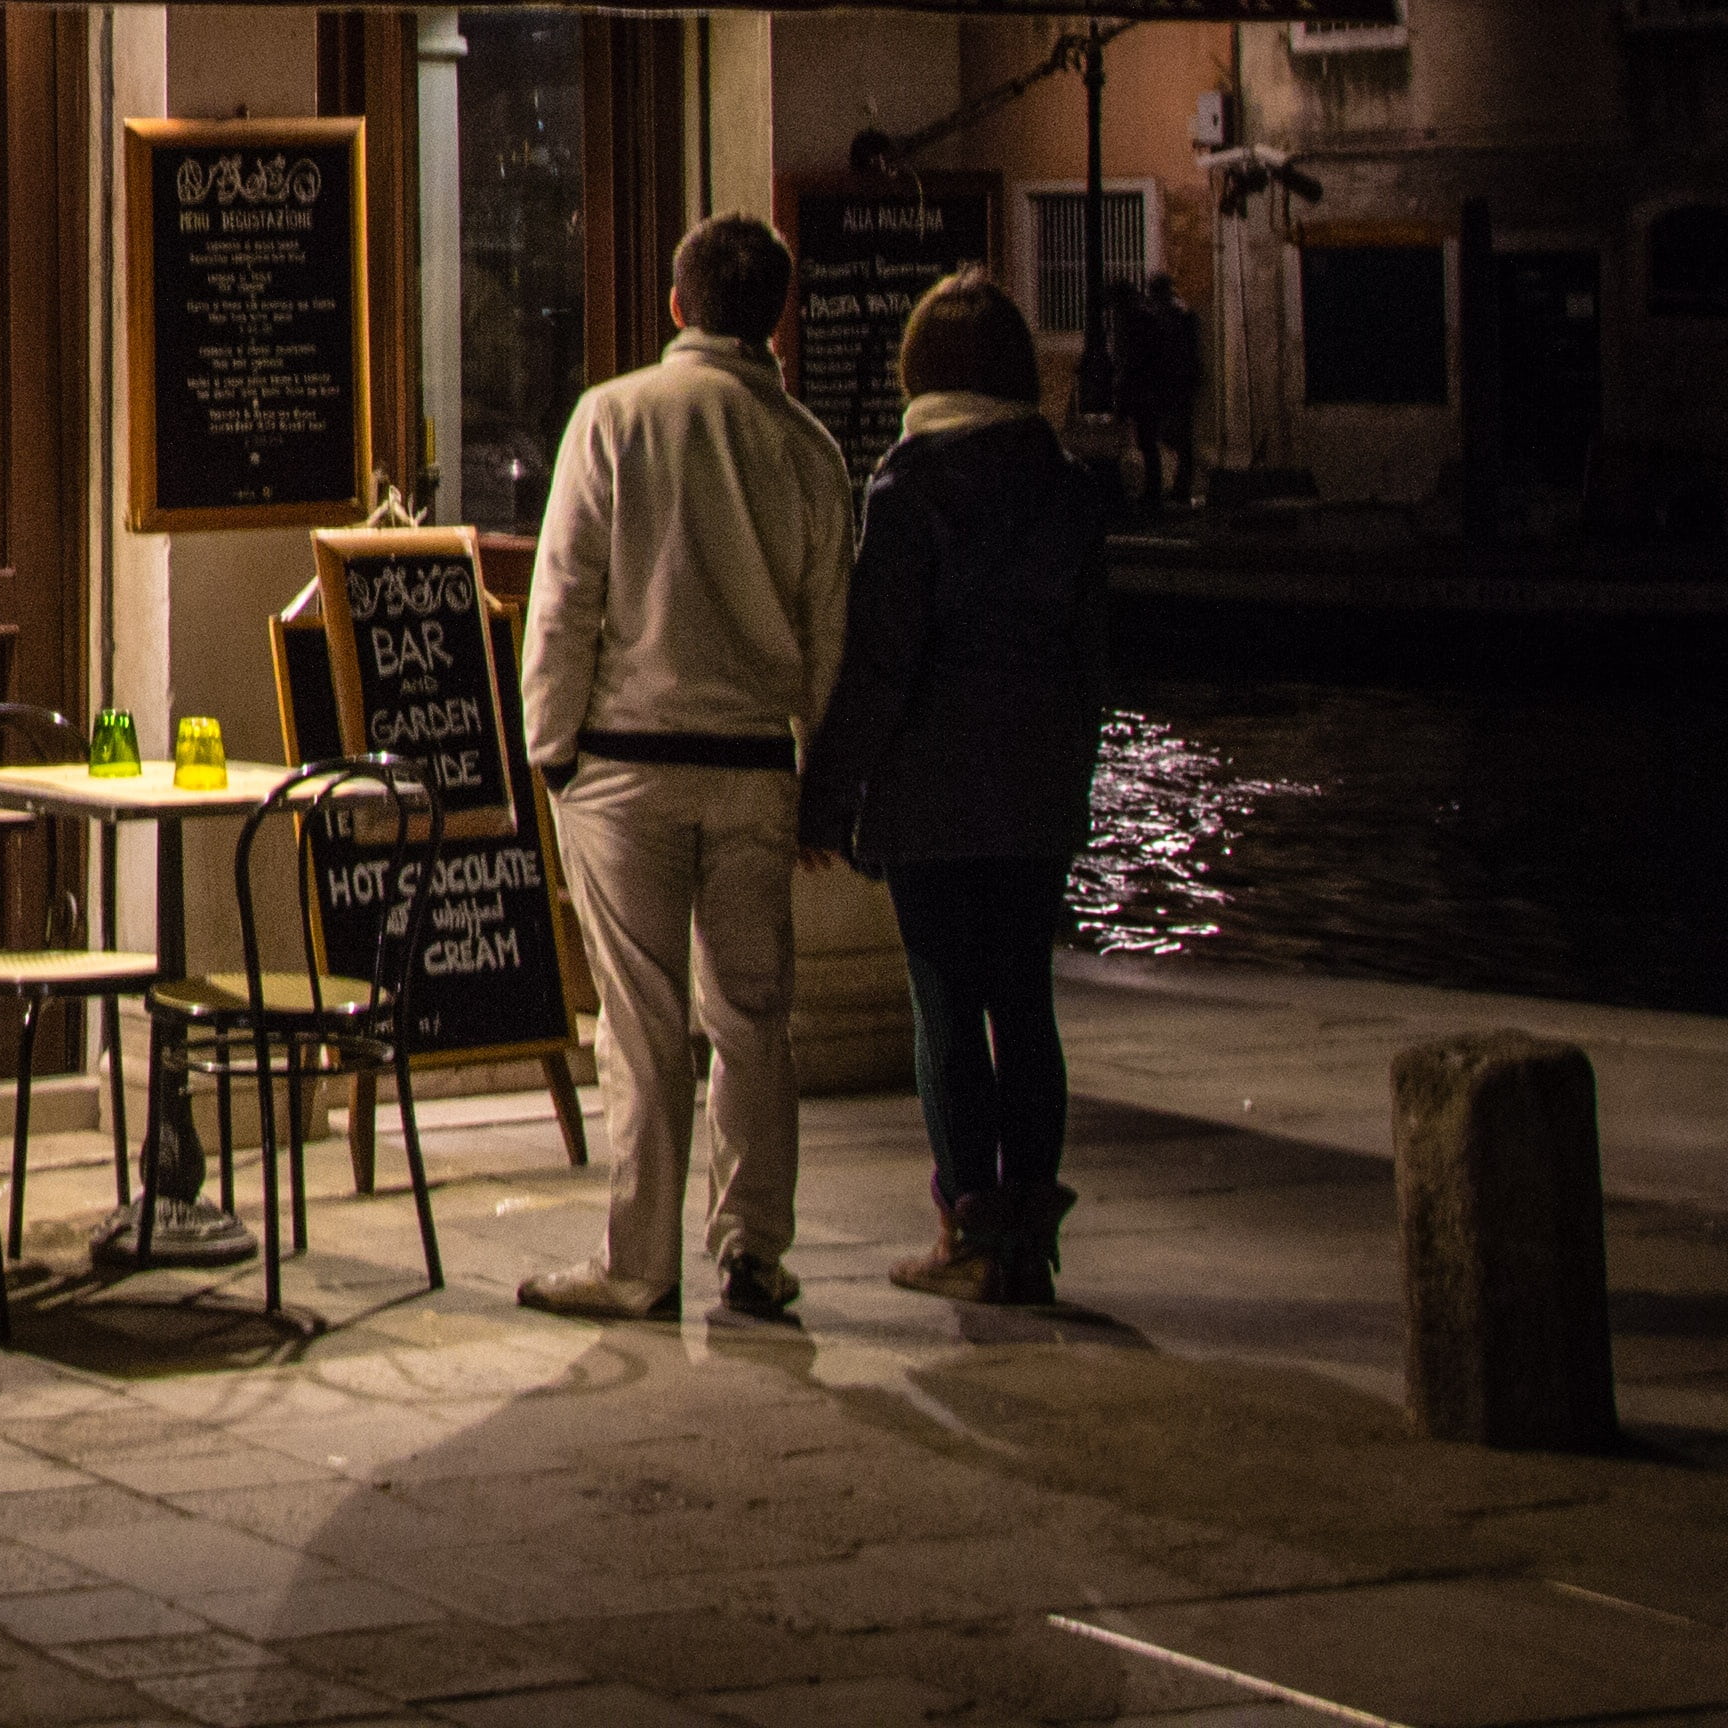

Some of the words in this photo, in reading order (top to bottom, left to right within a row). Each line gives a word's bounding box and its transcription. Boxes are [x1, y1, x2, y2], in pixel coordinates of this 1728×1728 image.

[220, 204, 313, 232] DEGUSTAZIONE
[371, 620, 453, 679] BAR
[370, 697, 482, 747] GARDEN
[327, 859, 390, 908] HOT
[397, 847, 542, 897] COCOLATE
[423, 927, 521, 977] CREAM
